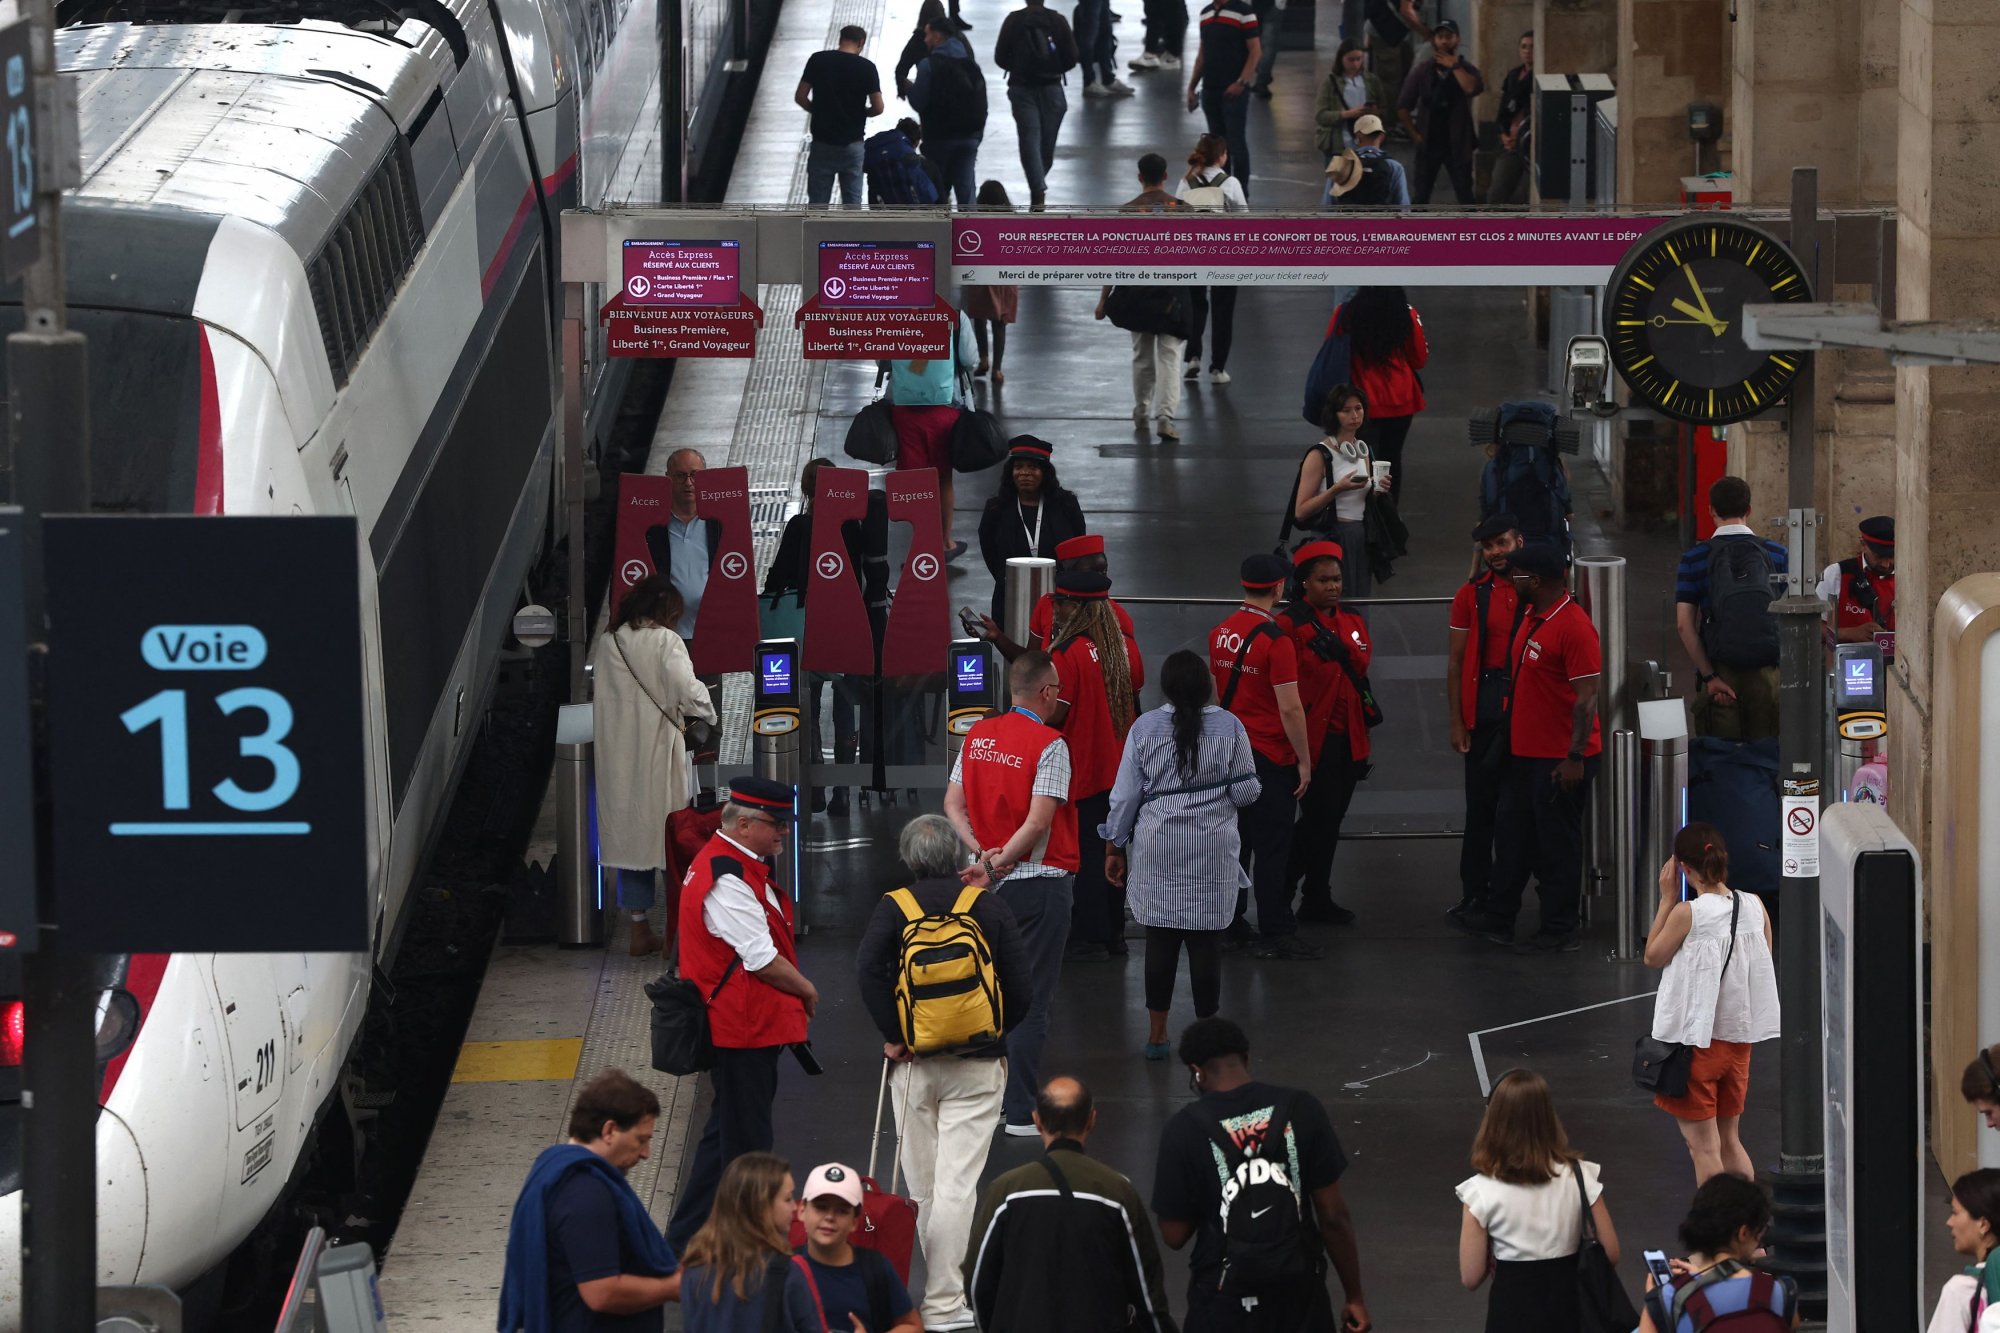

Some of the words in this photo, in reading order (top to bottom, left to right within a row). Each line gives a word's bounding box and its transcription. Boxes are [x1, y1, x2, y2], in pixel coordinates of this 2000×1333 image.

[998, 232, 1026, 241] POUR
[1030, 232, 1084, 241] RESPECTER
[1088, 232, 1100, 241] LA
[1102, 231, 1170, 241] PONCTUALITÉ
[1174, 233, 1192, 241] DES
[1196, 233, 1231, 241] TRAINS
[1234, 233, 1246, 241] ET
[1248, 233, 1260, 241] LE
[1262, 233, 1311, 241] CONFORT
[1314, 233, 1327, 241] DE
[1330, 233, 1360, 242] TOUS,
[1362, 233, 1456, 242] L'EMBARQUEMENT
[1460, 233, 1477, 241] EST
[1480, 232, 1505, 241] CLOS
[1508, 232, 1514, 241] 2
[1517, 232, 1561, 241] MINUTES
[1564, 232, 1600, 241] AVANT
[1602, 232, 1614, 241] LE
[648, 250, 675, 259] Accès
[678, 250, 713, 261] Express
[1000, 246, 1014, 254] TO
[1016, 246, 1044, 254] STICK
[1046, 246, 1059, 254] TO
[1062, 246, 1090, 254] TRAIN
[1092, 246, 1150, 255] SCHEDULES,
[1154, 246, 1206, 254] BOARDING
[1208, 246, 1216, 254] IS
[1219, 246, 1258, 254] CLOSED
[1260, 246, 1266, 254] 2
[1268, 246, 1312, 254] MINUTES
[1314, 246, 1350, 254] BEFORE
[1354, 246, 1410, 254] DEPARTURE
[845, 252, 870, 260] Accès
[874, 252, 908, 262] Express
[644, 260, 673, 268] RÉSERVÉ
[998, 270, 1025, 280] Merci
[1028, 270, 1040, 280] de
[1042, 270, 1084, 282] préparer
[1114, 270, 1136, 280] titre
[1138, 270, 1150, 280] de
[1153, 272, 1198, 282] transport
[1206, 271, 1234, 280] Please
[1236, 272, 1252, 282] get
[1253, 274, 1275, 282] your
[1276, 271, 1301, 280] ticket
[1303, 271, 1328, 282] ready
[610, 310, 668, 319] BIENVENUE
[670, 311, 690, 319] AUX
[694, 312, 754, 320] VOYAGEURS
[804, 312, 862, 320] BIENVENUE
[888, 313, 948, 321] VOYAGEURS
[634, 325, 677, 334] Business
[680, 326, 729, 336] Première,
[830, 328, 872, 336] Business
[876, 328, 924, 338] Première,
[612, 340, 648, 348] Liberté
[669, 340, 700, 349] Grand
[702, 340, 750, 351] Voyageur
[808, 342, 844, 350] Liberté
[864, 342, 895, 350] Grand
[898, 342, 944, 353] Voyageur
[700, 488, 743, 502] Express
[826, 488, 856, 499] Accès
[892, 490, 934, 502] Express
[630, 496, 660, 506] Accès
[157, 632, 249, 664] Voie
[119, 686, 300, 812] 13
[970, 738, 996, 749] SNCF
[256, 1038, 274, 1094] 211
